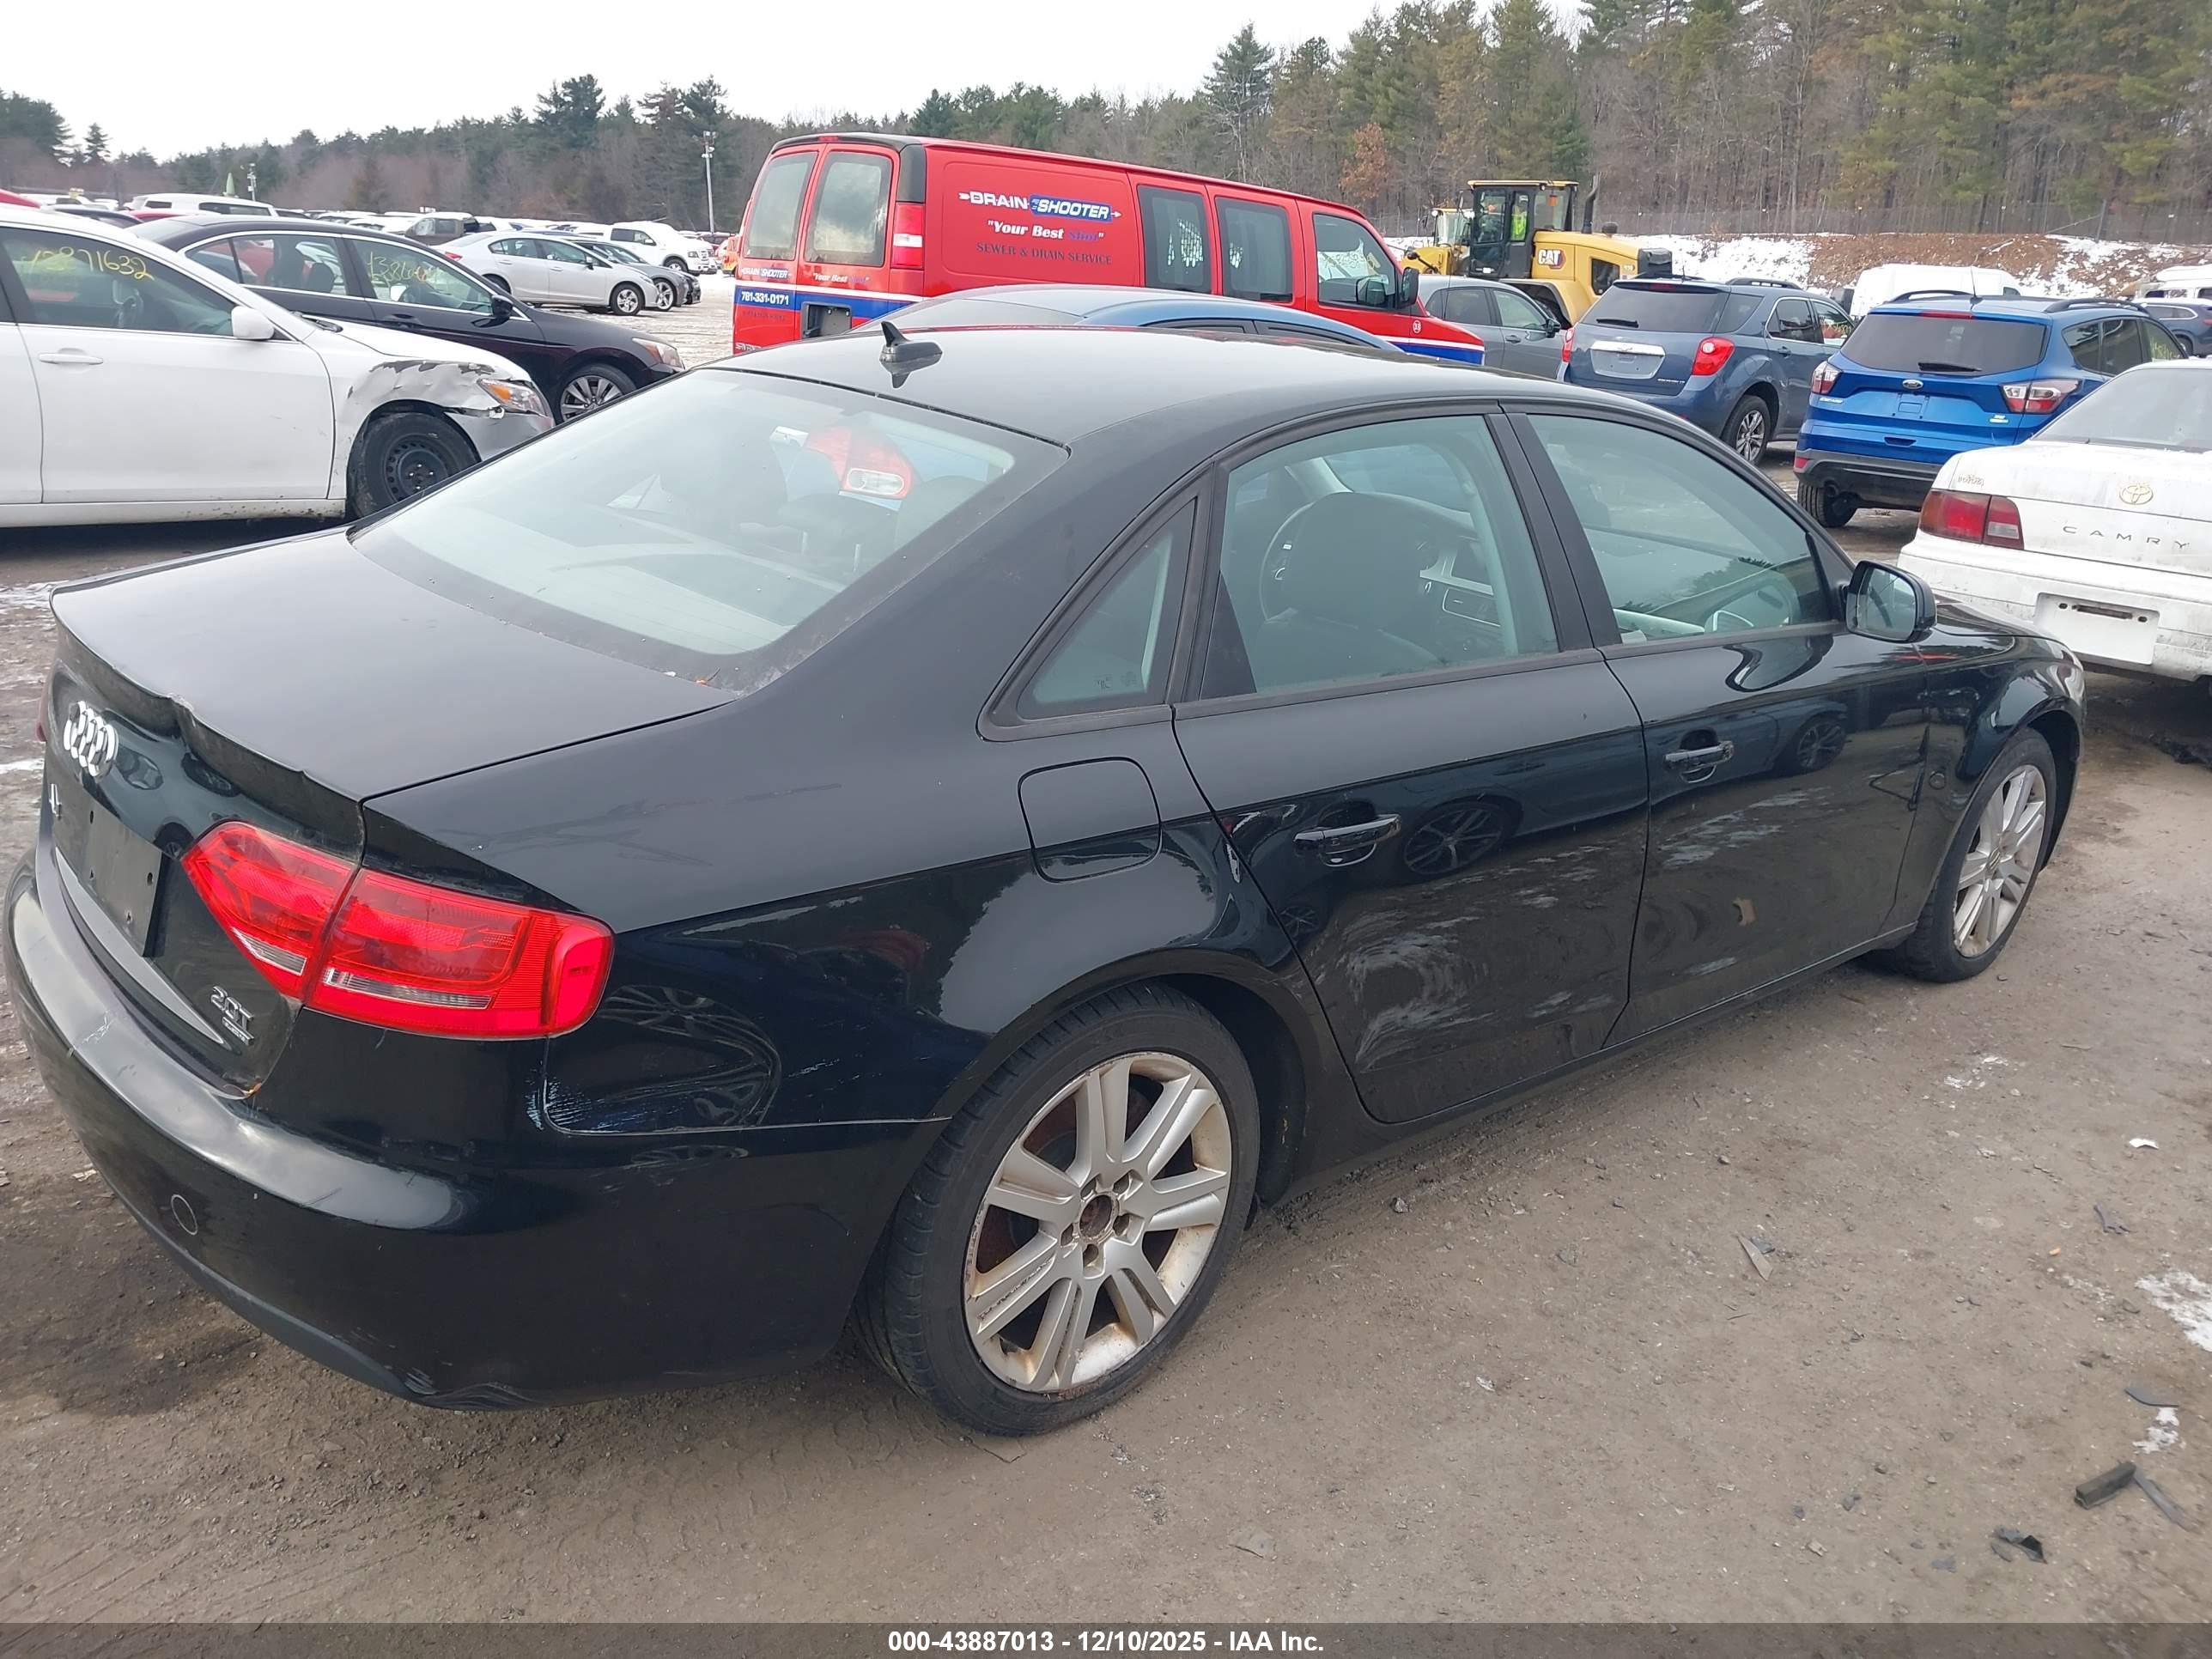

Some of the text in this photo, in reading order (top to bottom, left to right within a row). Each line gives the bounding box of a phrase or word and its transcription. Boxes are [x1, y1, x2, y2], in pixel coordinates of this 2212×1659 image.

[969, 191, 1109, 219] DRAIN SHOOTER
[988, 219, 1029, 236] "Your
[1031, 224, 1065, 240] Best
[975, 241, 1113, 265] SEWER & DRAIN SERVICE
[1538, 248, 1562, 266] CAT
[761, 267, 789, 280] SHOOTER
[831, 274, 848, 283] Best
[741, 290, 790, 306] 781-331-0171
[2062, 525, 2191, 550] CAMRY
